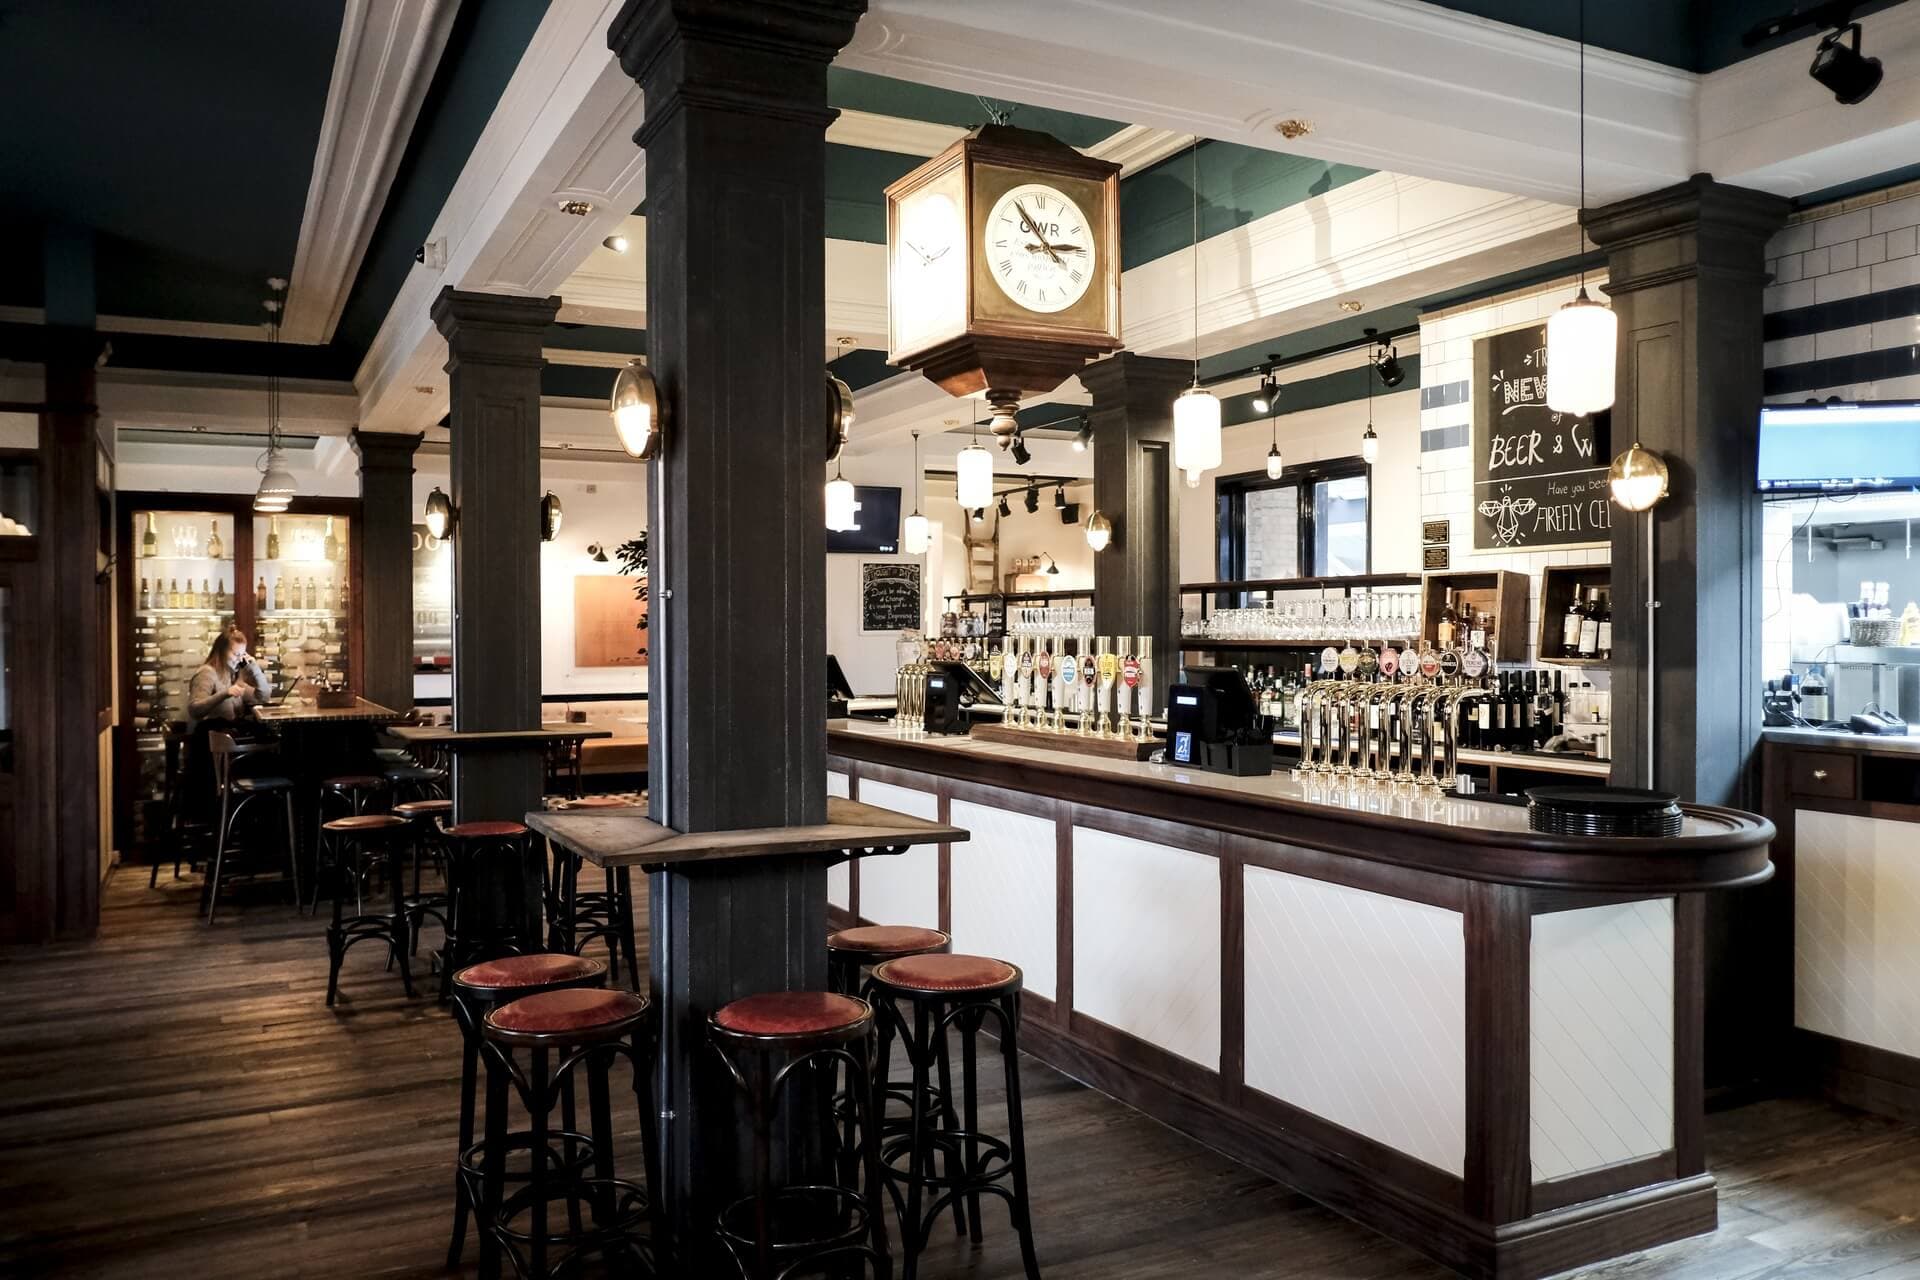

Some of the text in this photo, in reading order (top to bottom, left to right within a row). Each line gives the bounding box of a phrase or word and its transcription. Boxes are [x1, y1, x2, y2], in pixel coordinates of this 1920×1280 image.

[1019, 219, 1060, 237] GWR
[1488, 429, 1544, 471] BEER
[1552, 434, 1563, 454] &
[1547, 480, 1568, 496] Have
[1570, 484, 1585, 498] you
[1532, 502, 1583, 532] FIREFLY
